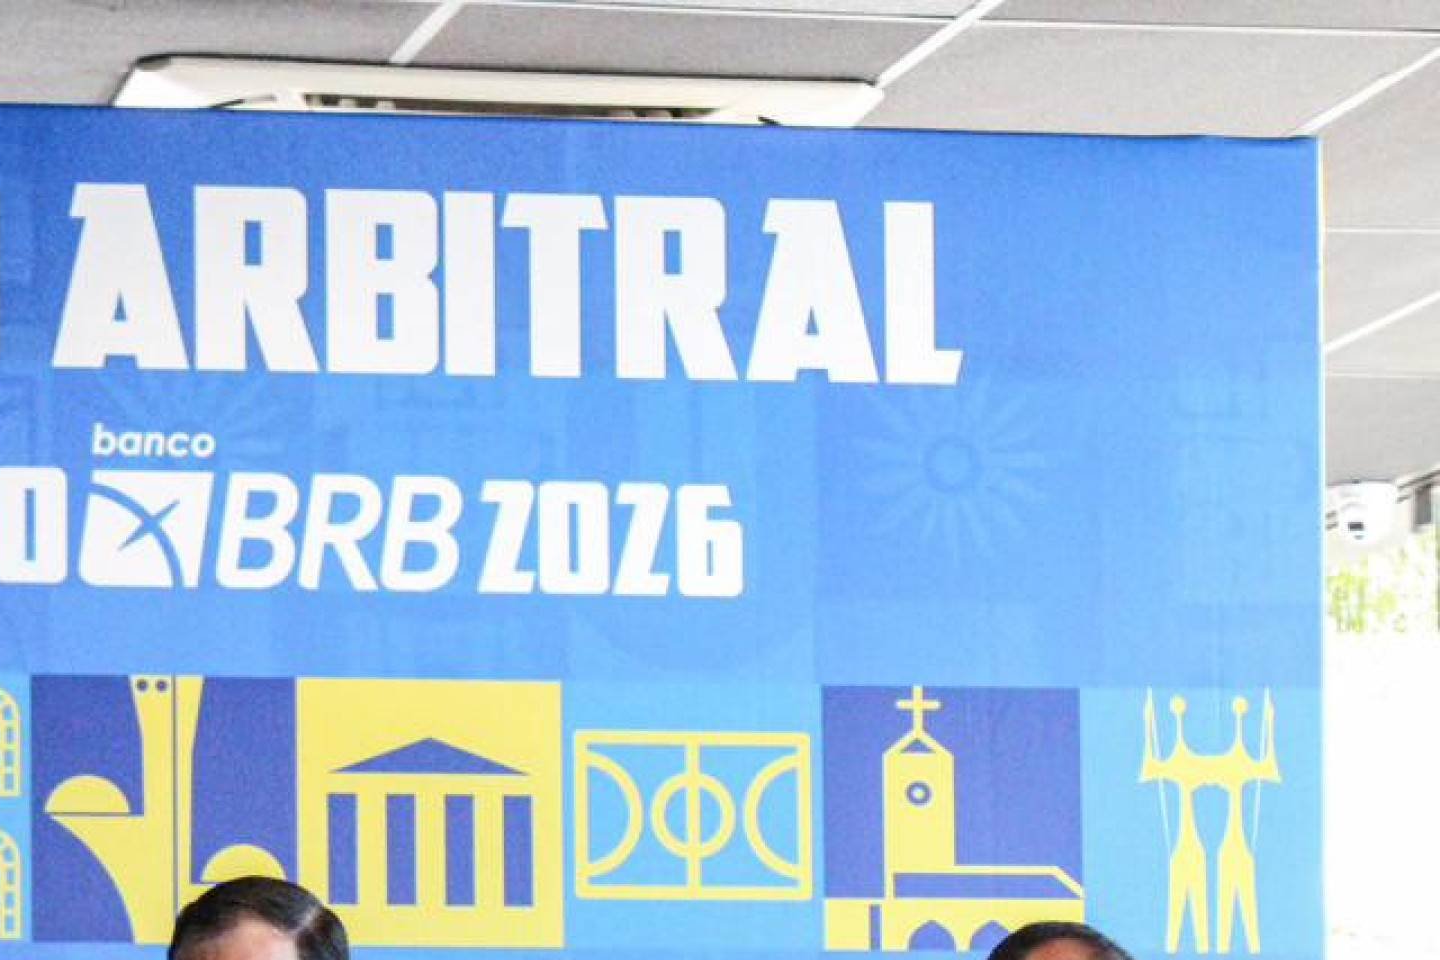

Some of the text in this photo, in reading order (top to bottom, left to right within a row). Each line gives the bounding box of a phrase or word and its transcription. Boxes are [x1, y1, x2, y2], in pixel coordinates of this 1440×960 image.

[51, 182, 963, 385] ARBITRAL
[92, 423, 216, 458] banco
[215, 473, 464, 592] BRB
[477, 480, 743, 596] 2026
